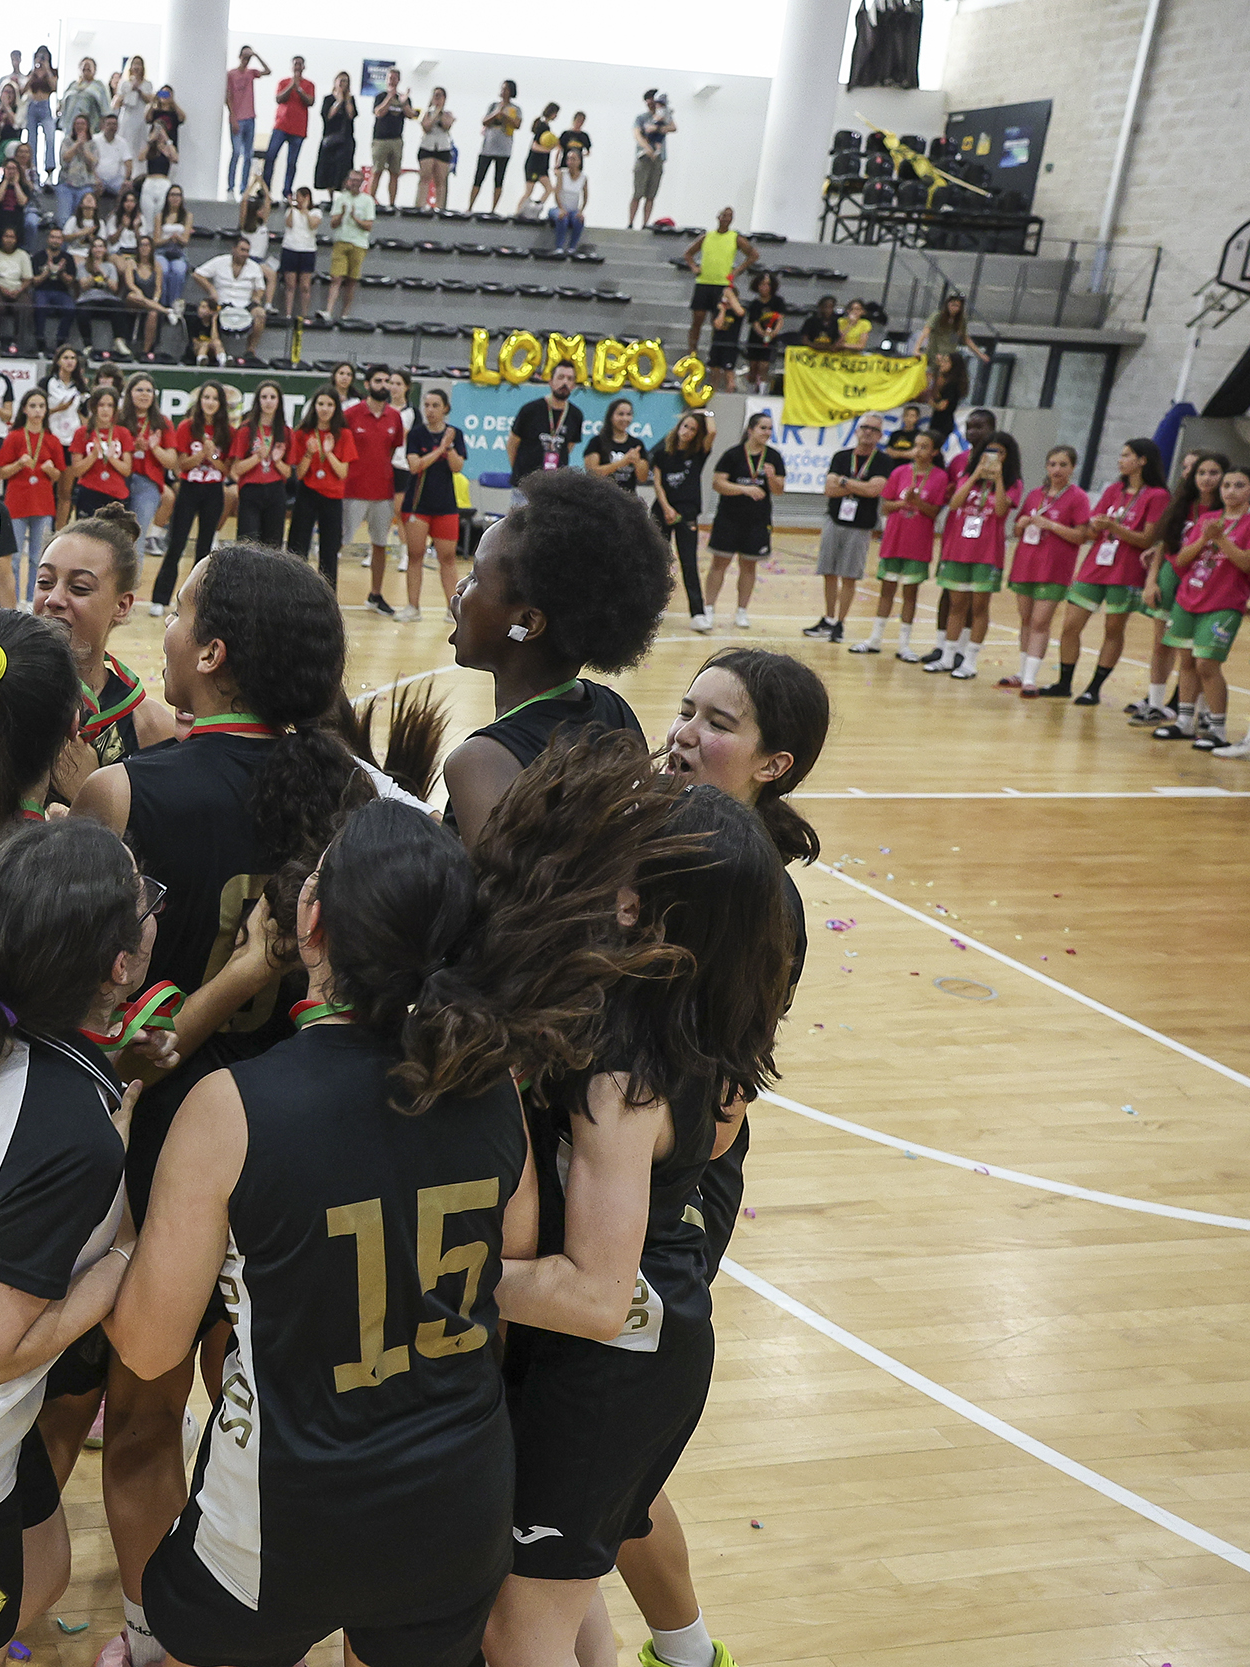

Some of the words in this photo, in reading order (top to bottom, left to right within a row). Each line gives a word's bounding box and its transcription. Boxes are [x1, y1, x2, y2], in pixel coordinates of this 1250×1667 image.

[842, 385, 867, 398] EM
[464, 414, 479, 430] O
[325, 1176, 500, 1394] 15
